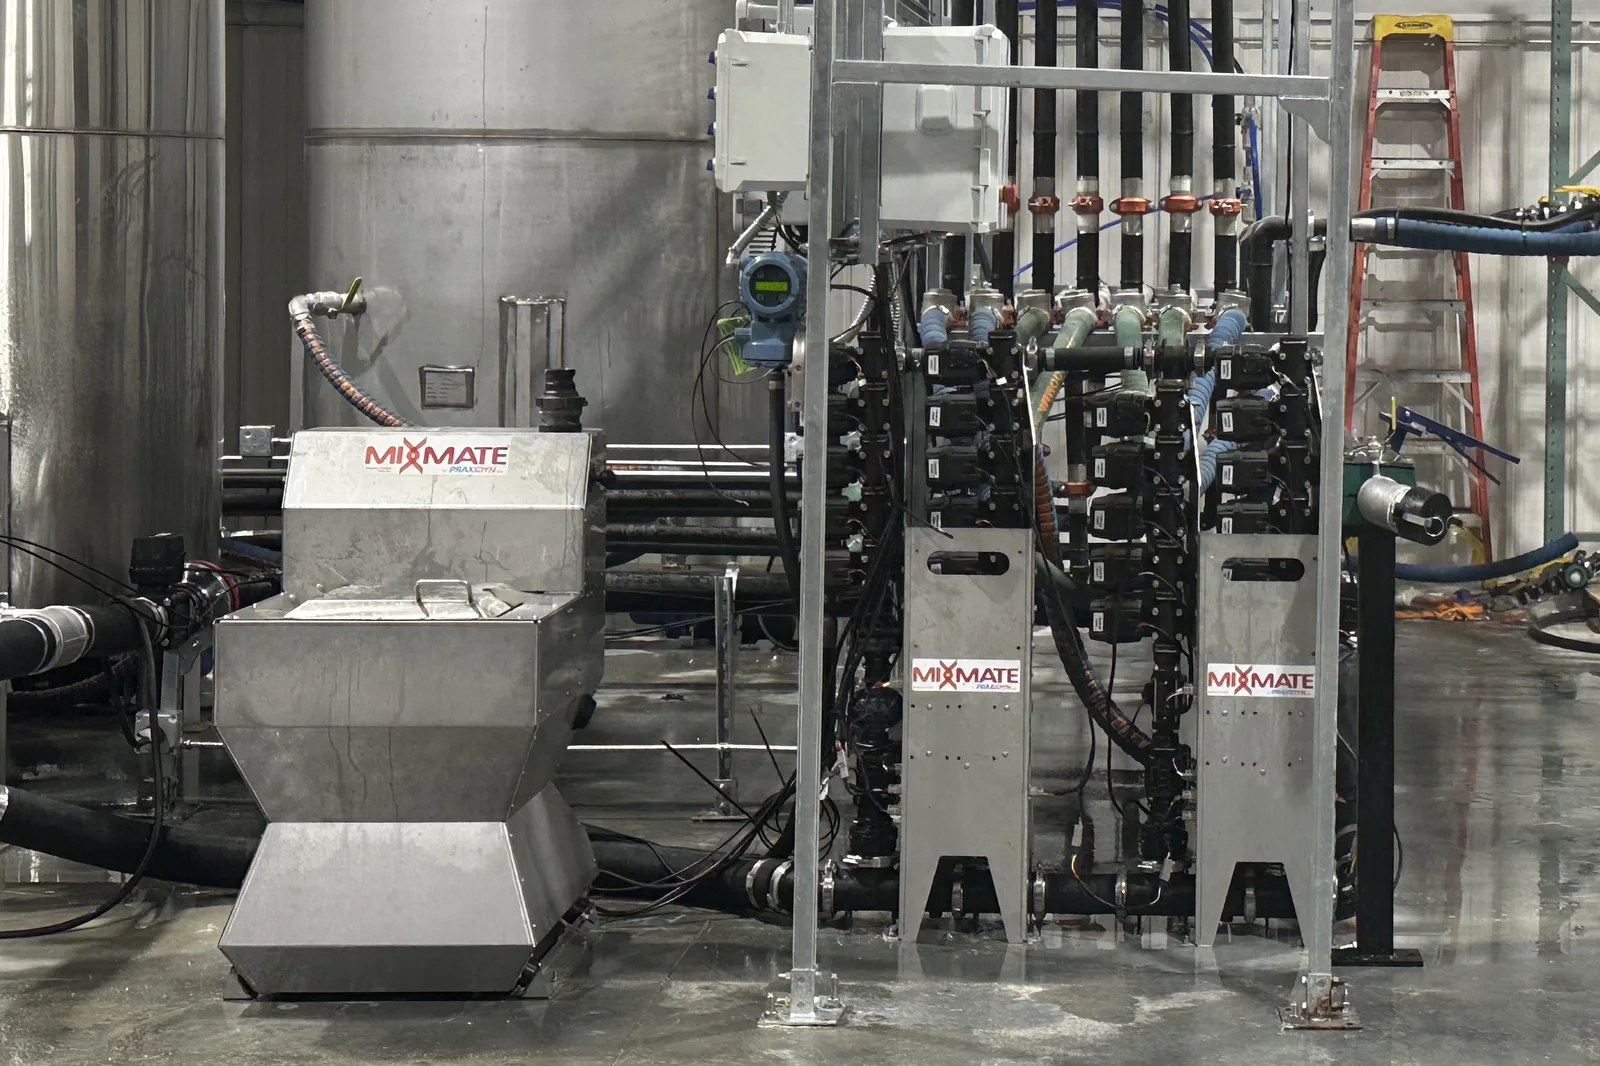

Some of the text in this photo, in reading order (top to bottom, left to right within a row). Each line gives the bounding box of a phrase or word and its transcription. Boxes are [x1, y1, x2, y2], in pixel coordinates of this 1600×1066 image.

[365, 437, 508, 474] MIXMATE
[913, 660, 1018, 690] MIXMATE
[1208, 665, 1314, 695] MIXMATE
